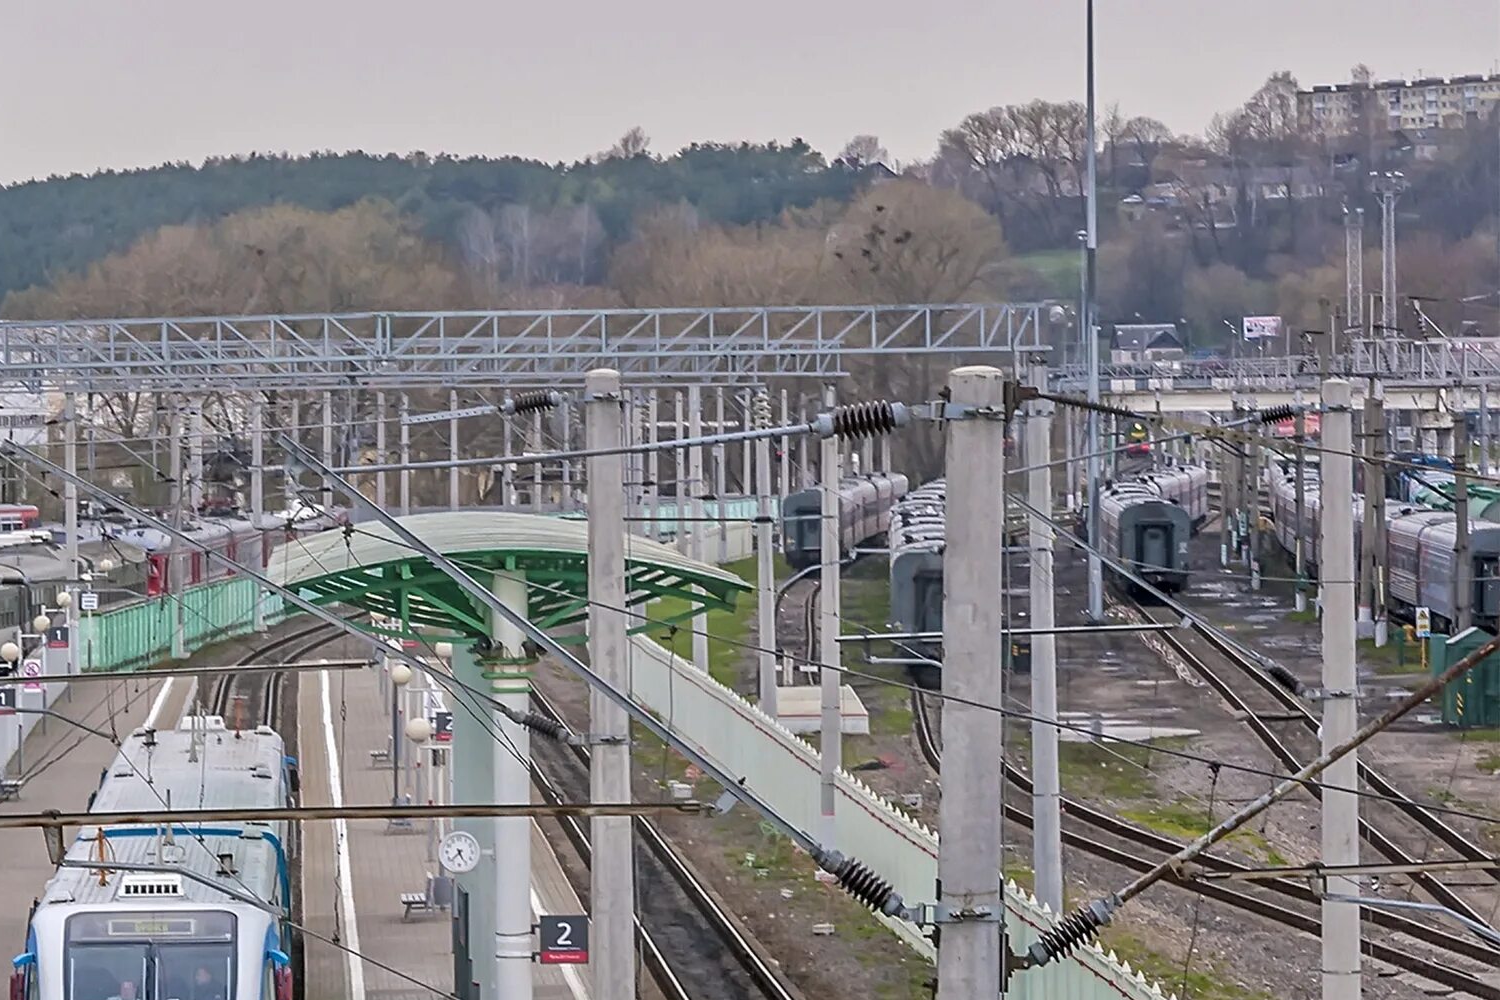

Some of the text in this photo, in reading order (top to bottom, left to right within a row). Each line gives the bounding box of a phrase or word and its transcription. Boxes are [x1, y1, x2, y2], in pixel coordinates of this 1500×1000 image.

[55, 630, 61, 640] 1
[0, 692, 6, 705] 1
[556, 922, 572, 945] 2
